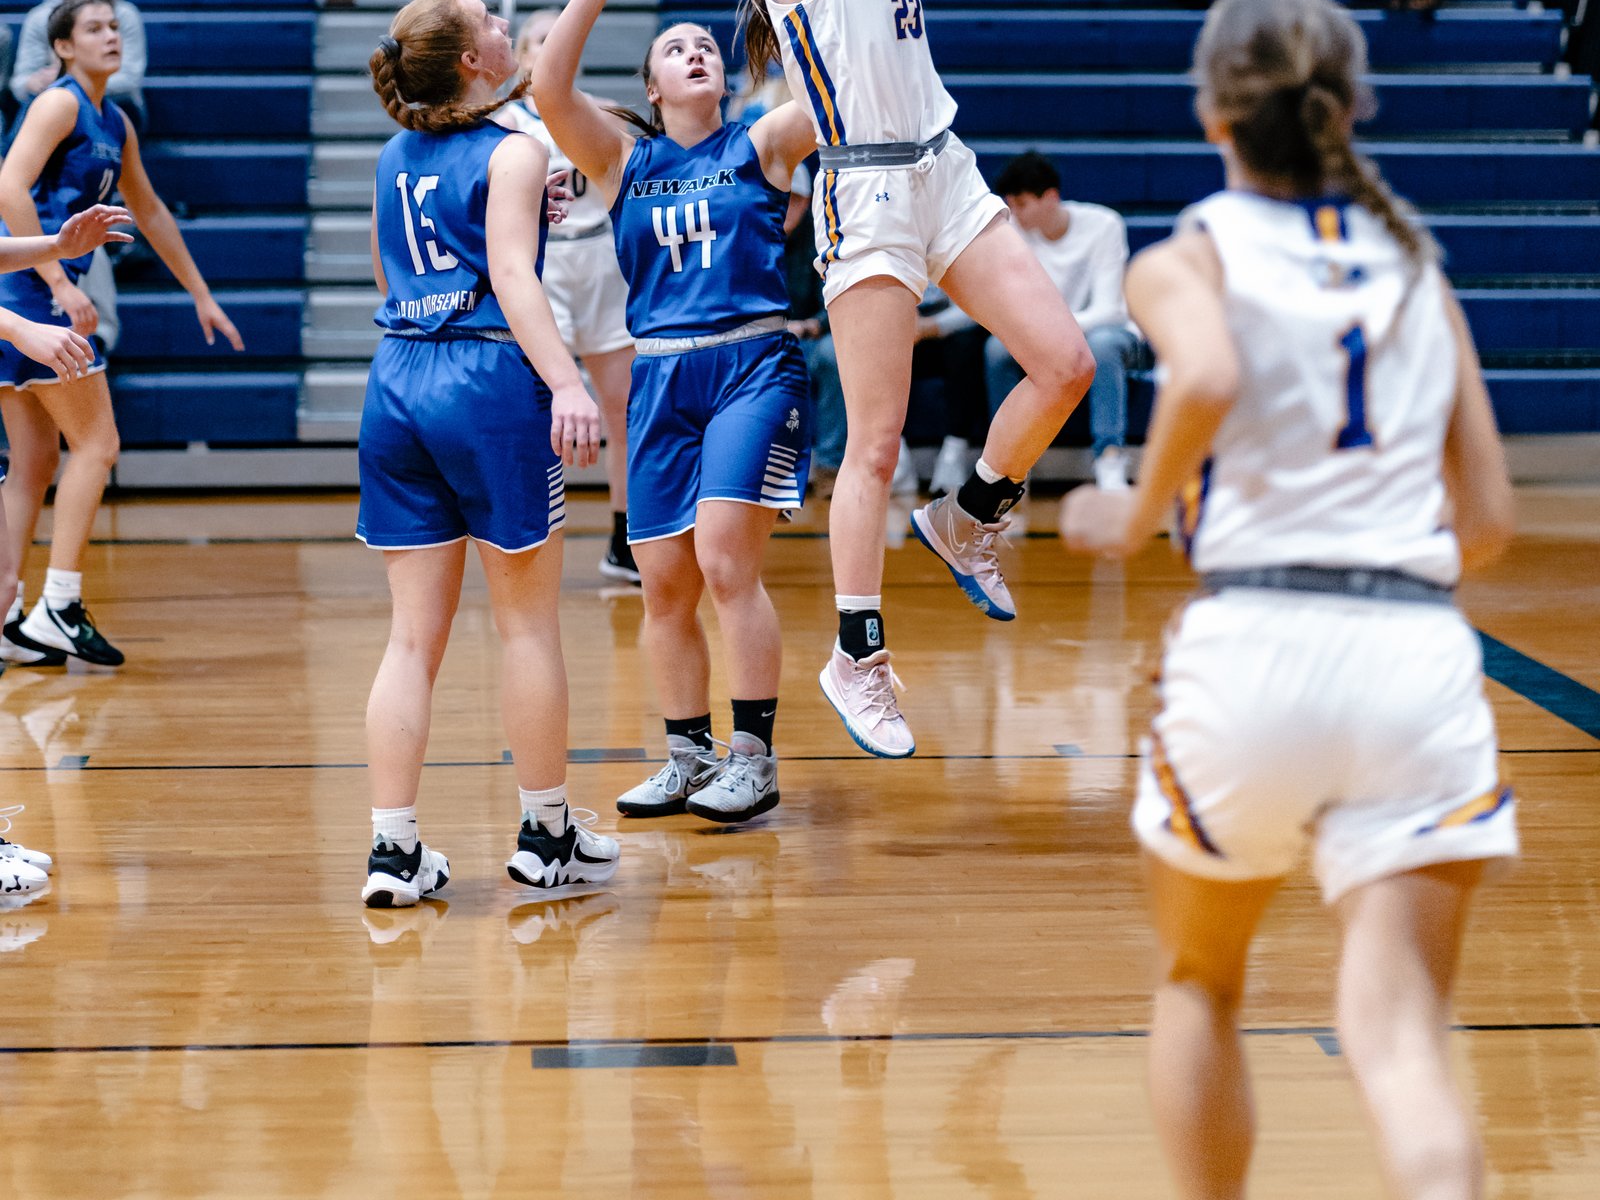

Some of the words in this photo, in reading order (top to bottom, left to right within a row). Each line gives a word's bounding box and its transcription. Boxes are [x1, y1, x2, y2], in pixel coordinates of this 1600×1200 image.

[396, 172, 459, 276] 15
[628, 169, 736, 199] NEWARK
[652, 199, 717, 273] 44
[1333, 321, 1377, 451] 1
